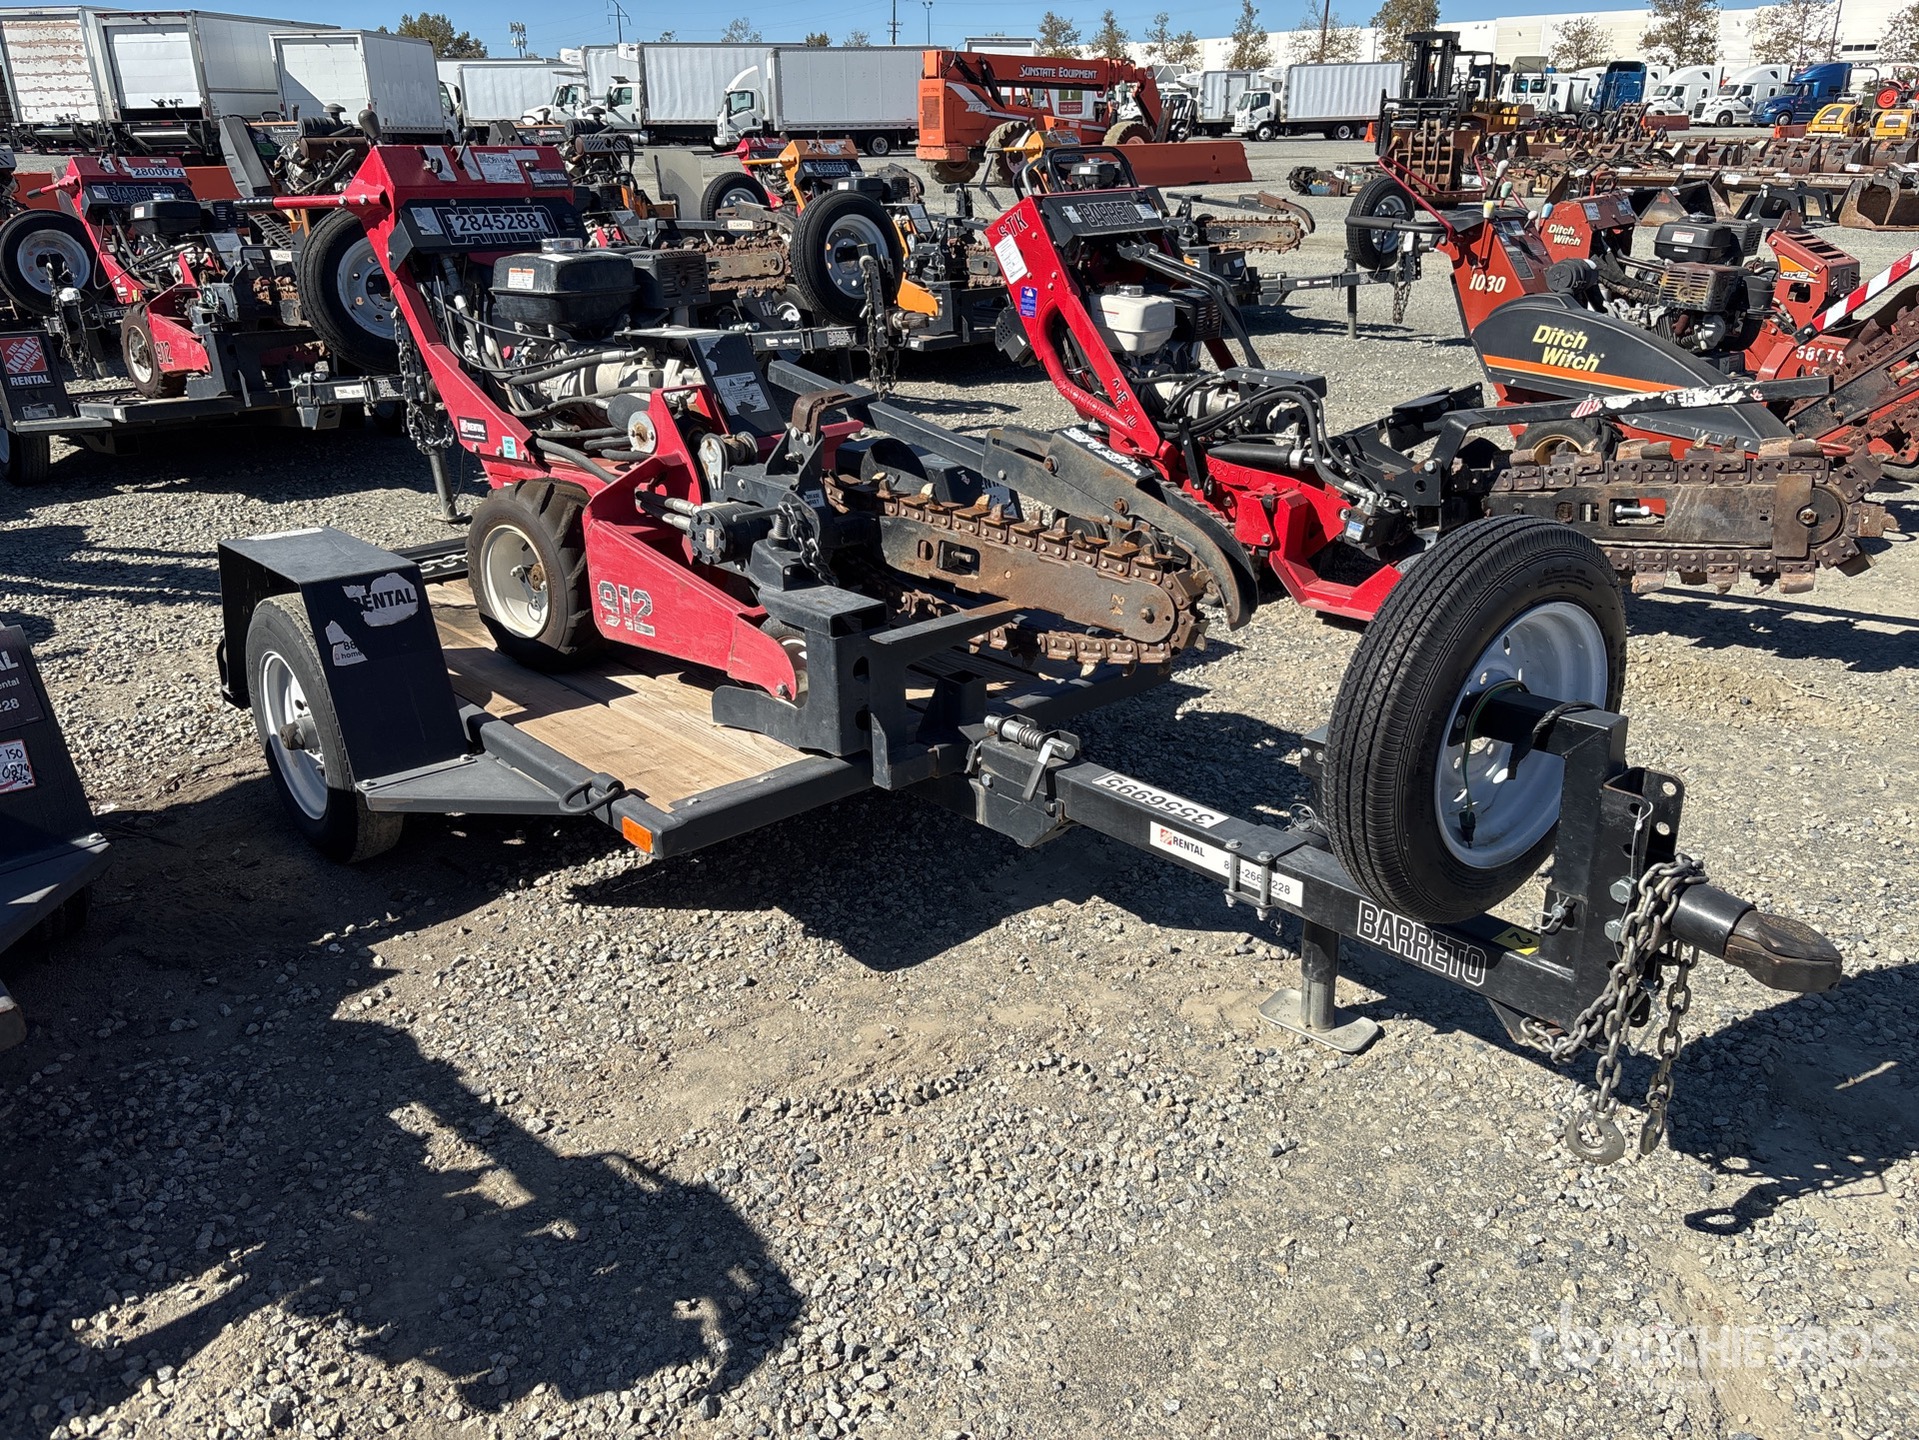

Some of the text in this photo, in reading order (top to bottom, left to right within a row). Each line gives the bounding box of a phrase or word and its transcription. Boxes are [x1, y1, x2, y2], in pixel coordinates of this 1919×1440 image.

[1019, 65, 1097, 79] SUNSTATE EQUIPMENT
[134, 168, 184, 178] 2800074
[455, 213, 541, 232] 2845288
[998, 208, 1029, 239] STK
[1077, 200, 1145, 227] BARRETO
[1547, 224, 1575, 236] Ditch
[1552, 234, 1581, 246] Witch
[1469, 273, 1507, 293] 1030
[1533, 325, 1588, 350] Ditch
[155, 341, 174, 366] 912
[1542, 346, 1600, 372] Witch
[10, 375, 51, 386] RENTAL
[358, 588, 416, 612] ENTAL
[598, 580, 656, 637] 912
[1101, 778, 1215, 825] 3556995
[1172, 835, 1205, 858] RENTAL
[1356, 899, 1487, 987] BARRETO
